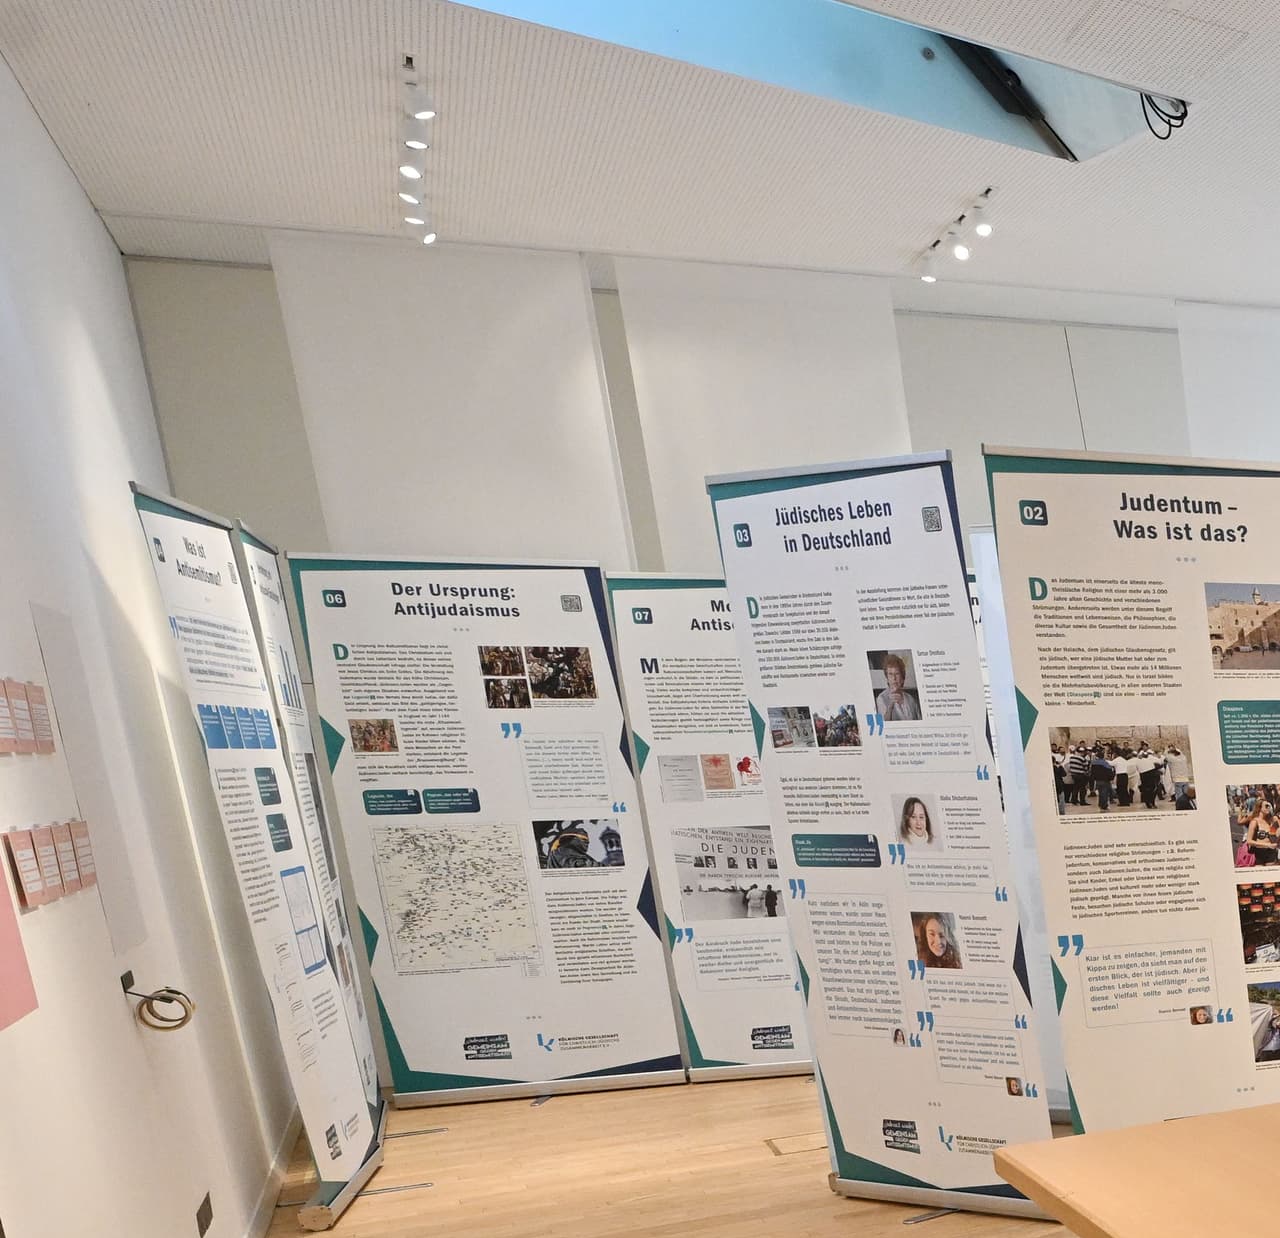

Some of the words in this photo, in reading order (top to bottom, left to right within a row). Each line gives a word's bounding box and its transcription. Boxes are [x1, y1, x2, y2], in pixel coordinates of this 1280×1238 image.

[1119, 492, 1222, 515] Judentum
[775, 504, 844, 526] Jüdisches
[847, 500, 892, 520] Leben
[1023, 506, 1043, 521] 02
[736, 529, 749, 543] 03
[783, 535, 798, 553] in
[801, 526, 892, 551] Deutschland
[1112, 519, 1158, 539] Was
[1165, 521, 1193, 541] ist
[1200, 523, 1248, 543] das?
[176, 558, 223, 587] Antisemitismus?
[325, 593, 343, 604] 06
[390, 582, 422, 596] Der
[428, 583, 515, 601] Ursprung:
[394, 601, 520, 619] Antijudaismus
[635, 611, 650, 620] 07
[1124, 951, 1158, 959] einfacher,
[1159, 948, 1193, 958] jemanden
